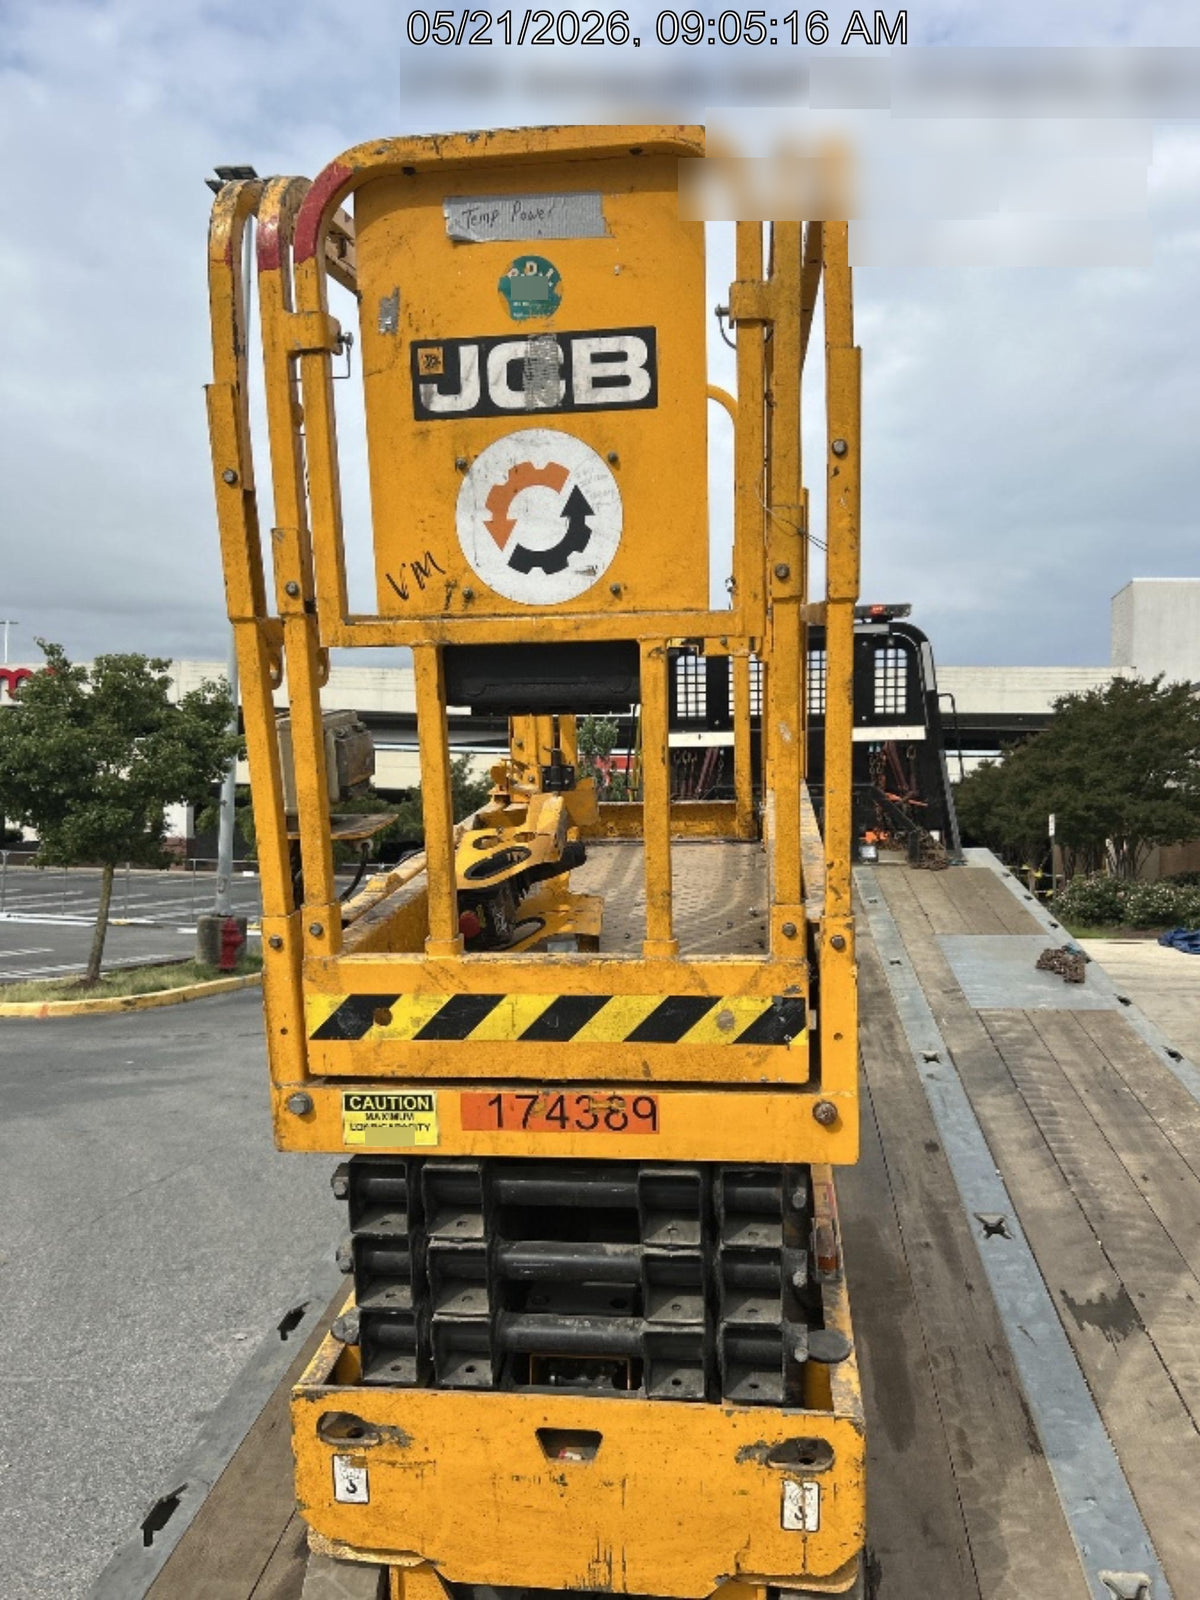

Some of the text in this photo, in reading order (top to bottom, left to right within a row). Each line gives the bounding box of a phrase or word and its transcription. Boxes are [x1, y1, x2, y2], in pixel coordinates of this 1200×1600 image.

[462, 201, 556, 229] Temp Power
[419, 335, 652, 413] JCB
[349, 1096, 430, 1110] CAUTION
[488, 1093, 657, 1131] 174389
